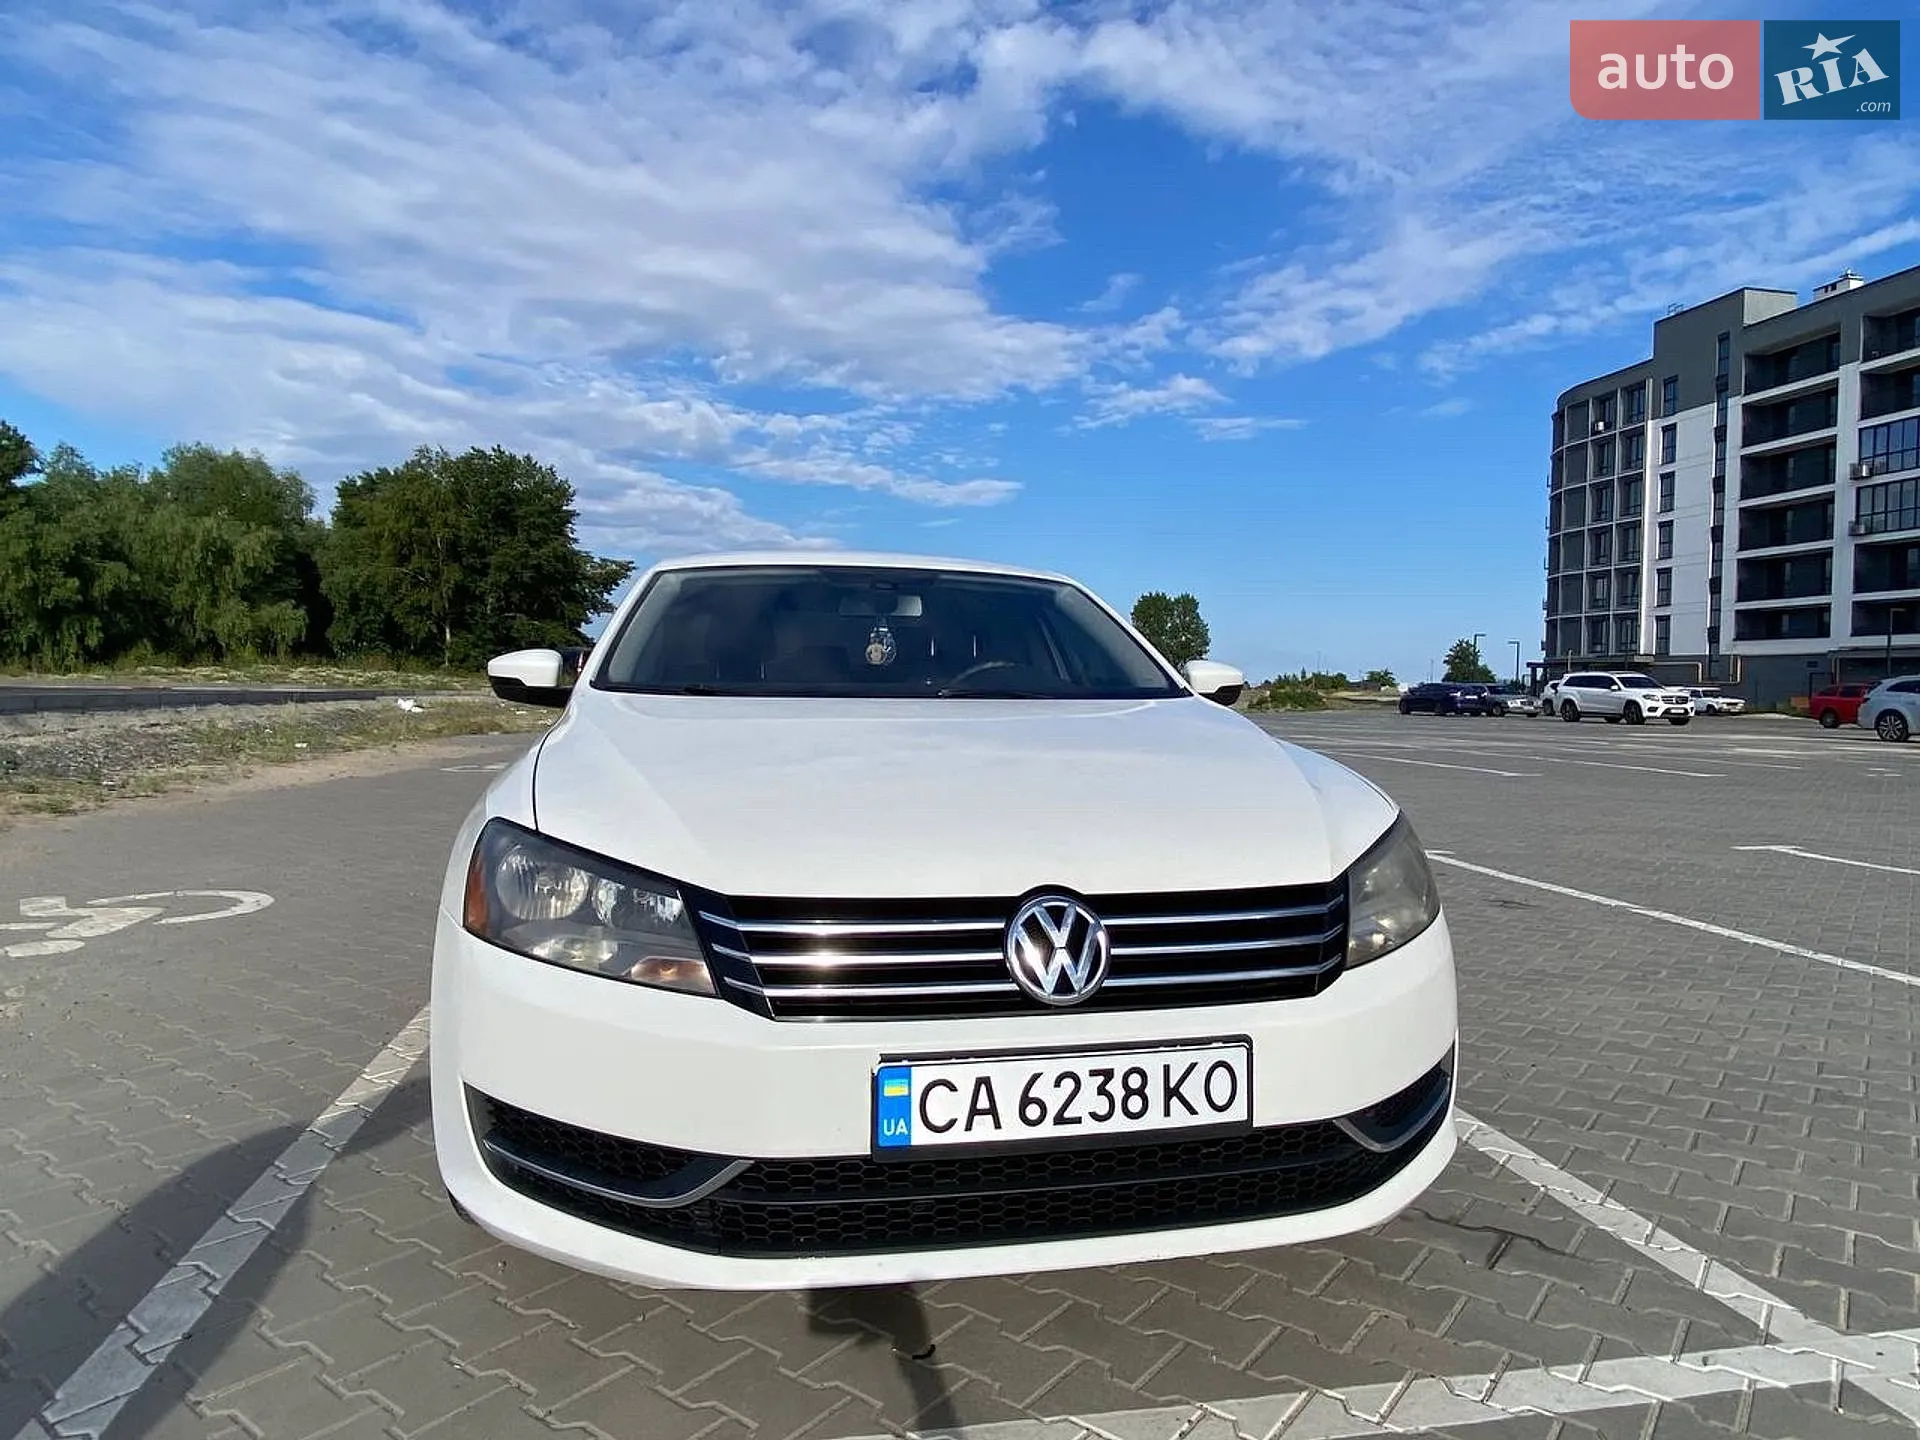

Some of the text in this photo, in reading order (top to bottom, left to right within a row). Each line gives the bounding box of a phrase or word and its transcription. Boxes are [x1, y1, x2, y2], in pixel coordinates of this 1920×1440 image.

[919, 1060, 1238, 1133] CA 6238 KO
[883, 1117, 909, 1136] UA
